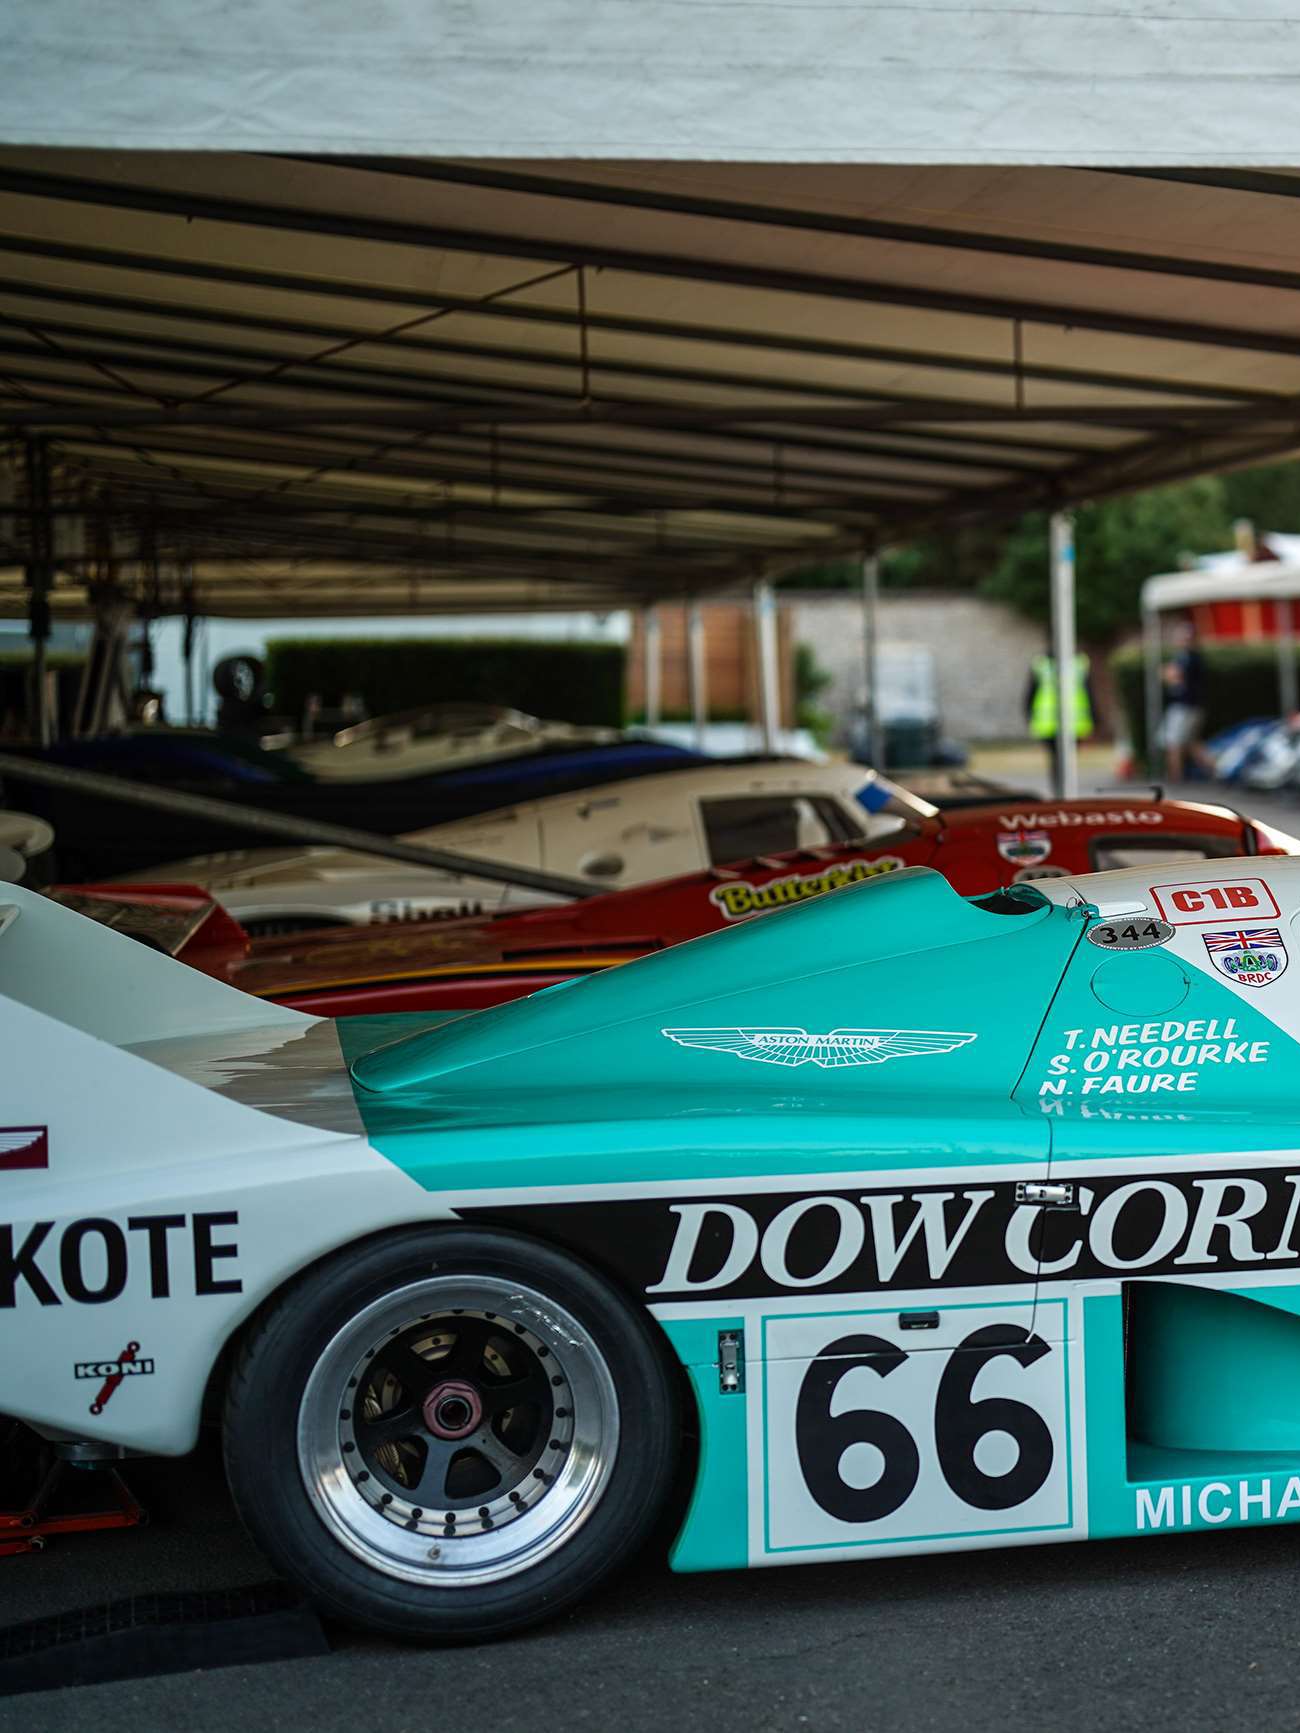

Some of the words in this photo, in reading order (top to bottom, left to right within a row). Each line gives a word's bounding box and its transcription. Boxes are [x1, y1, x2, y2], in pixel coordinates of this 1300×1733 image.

[999, 809, 1164, 830] Webasto
[1171, 886, 1260, 912] C1B
[1099, 921, 1161, 944] 344
[1237, 971, 1272, 984] BRDC
[758, 1035, 809, 1045] ASTON
[815, 1036, 875, 1046] MARTIN
[1091, 1018, 1239, 1049] NEEDELL
[1047, 1055, 1077, 1075] S.
[1083, 1041, 1271, 1073] O'ROURKE
[1039, 1079, 1073, 1095] N.
[1081, 1072, 1199, 1095] FAURE
[645, 1190, 996, 1294] DOW
[0, 1211, 243, 1309] KOTE
[76, 1360, 154, 1377] KONI
[795, 1323, 1054, 1523] 66
